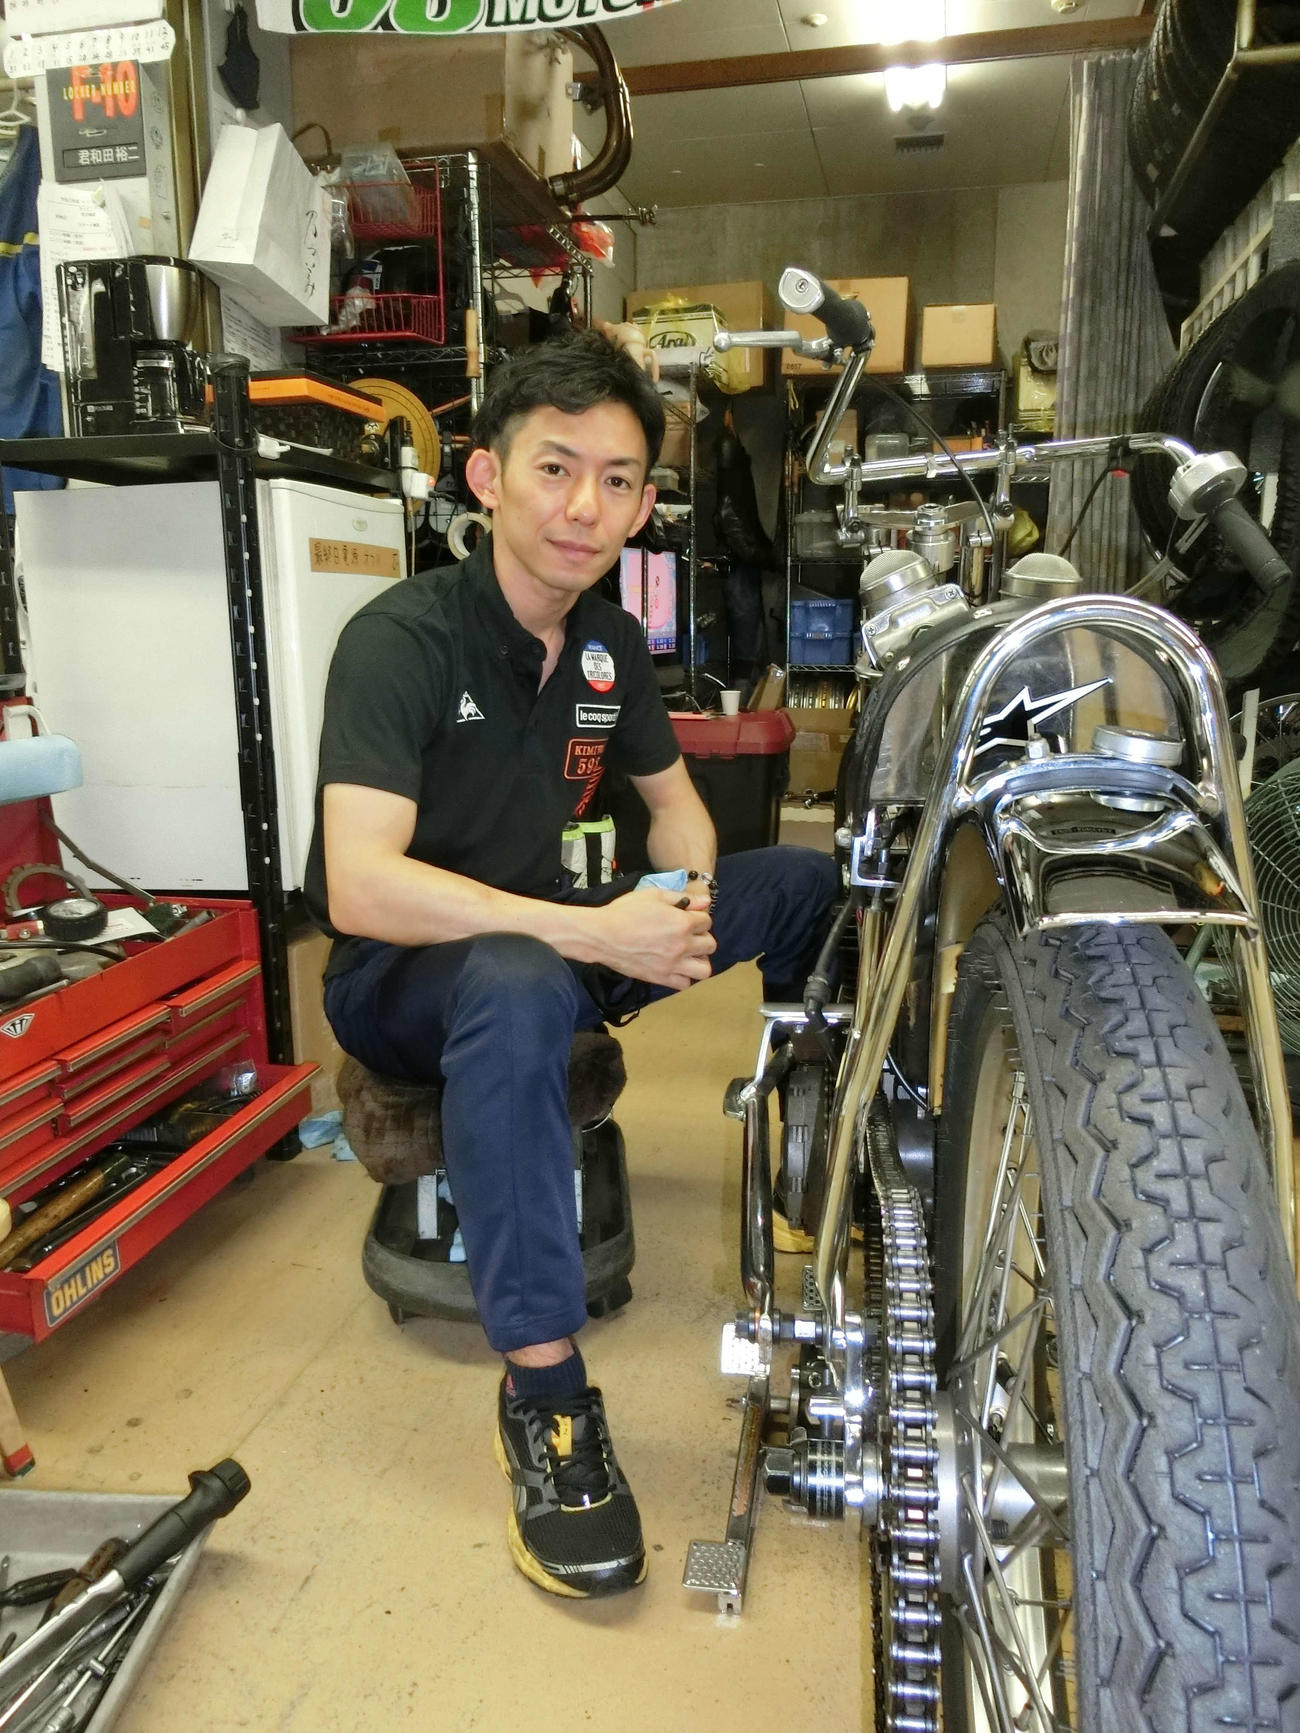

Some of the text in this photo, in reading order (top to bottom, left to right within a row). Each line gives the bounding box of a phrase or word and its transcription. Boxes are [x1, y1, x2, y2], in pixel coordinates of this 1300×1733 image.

[78, 145, 140, 165] 君和田裕二
[591, 653, 608, 663] MARQUE
[580, 710, 588, 721] le
[588, 712, 601, 723] coq
